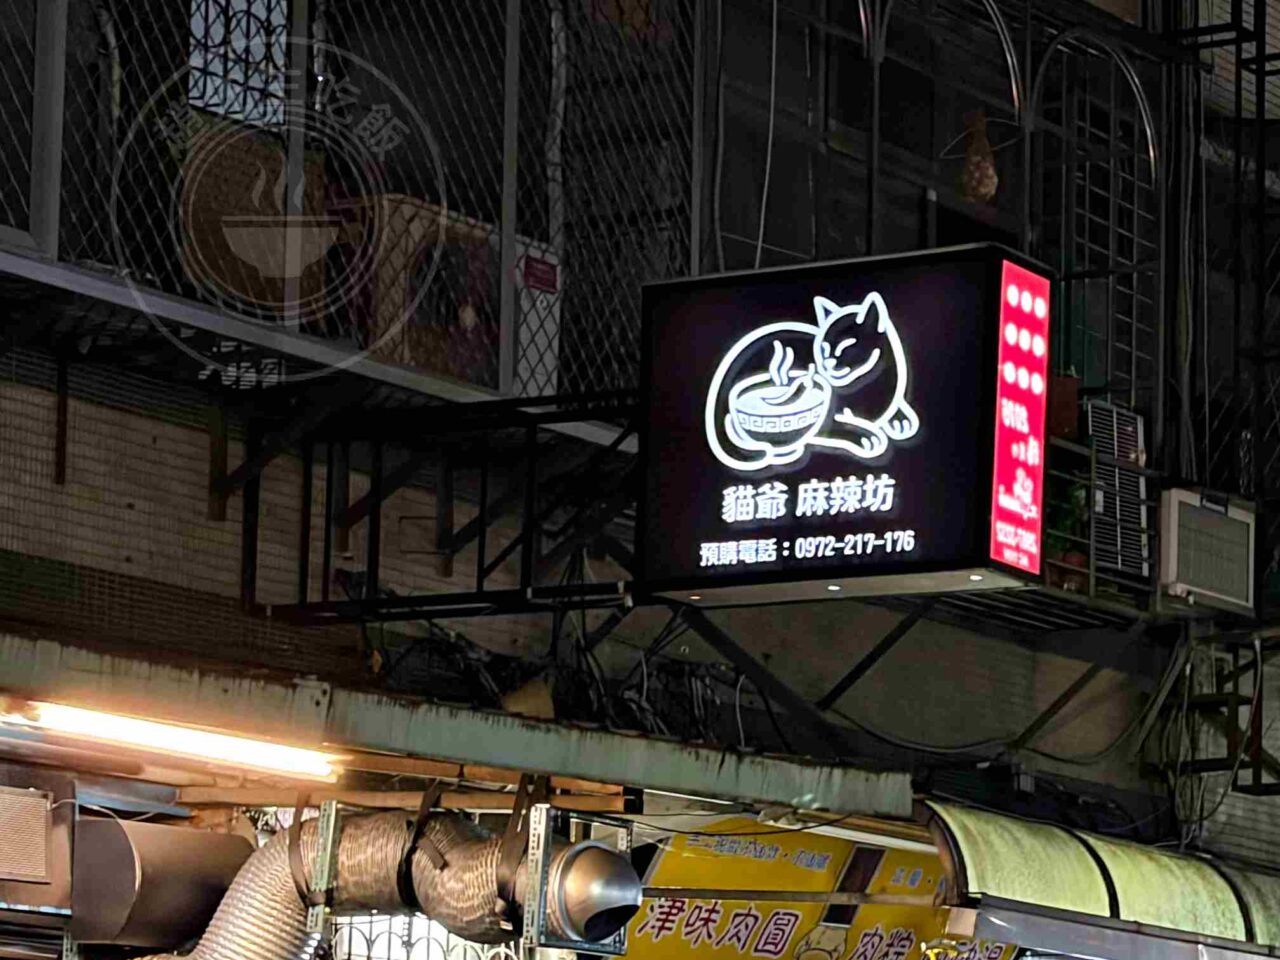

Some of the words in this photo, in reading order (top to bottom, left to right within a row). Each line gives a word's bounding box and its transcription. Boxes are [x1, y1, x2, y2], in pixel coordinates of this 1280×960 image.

[721, 482, 789, 524] 貓爺
[795, 475, 896, 517] 麻辣坊
[636, 896, 801, 959] 津味肉圓
